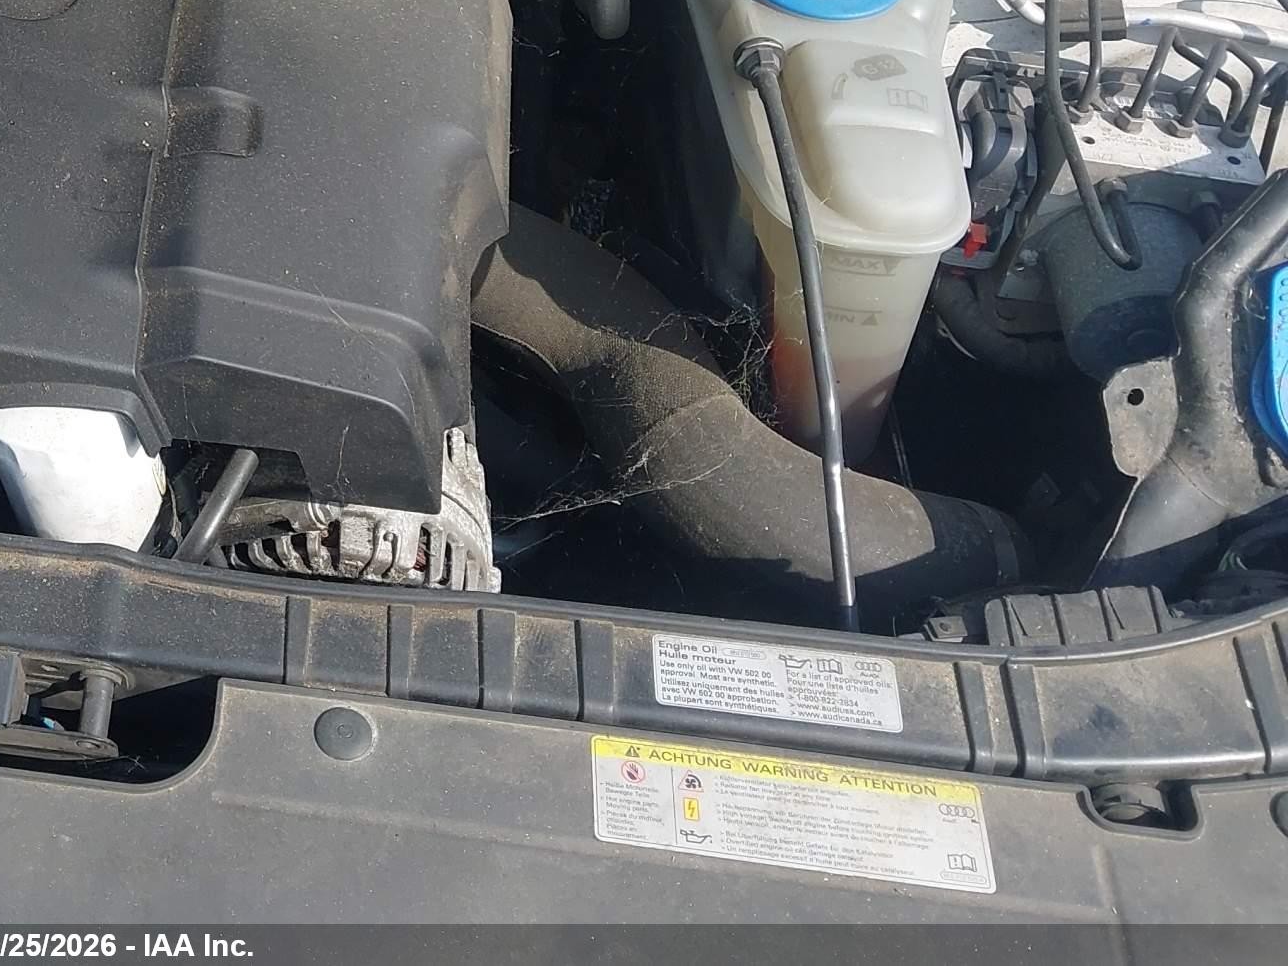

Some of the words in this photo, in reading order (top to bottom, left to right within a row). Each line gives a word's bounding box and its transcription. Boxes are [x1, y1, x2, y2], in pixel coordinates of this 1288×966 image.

[658, 640, 697, 653] Engine
[702, 644, 717, 654] Oil
[659, 650, 688, 659] Huile
[692, 654, 736, 665] moteur
[677, 662, 694, 672] only
[708, 665, 726, 673] with
[727, 667, 742, 675] VW
[744, 669, 759, 677] 502
[700, 672, 720, 680] Most
[808, 672, 820, 680] list
[661, 677, 689, 687] Utilisez
[692, 681, 740, 695] uniquement
[742, 687, 757, 695] des
[760, 689, 784, 699] huiles
[674, 696, 702, 706] plupart
[704, 699, 722, 707] sont
[648, 749, 732, 769] ACHTUNG
[741, 761, 828, 782] WARNING
[839, 773, 937, 796] ATTENTION
